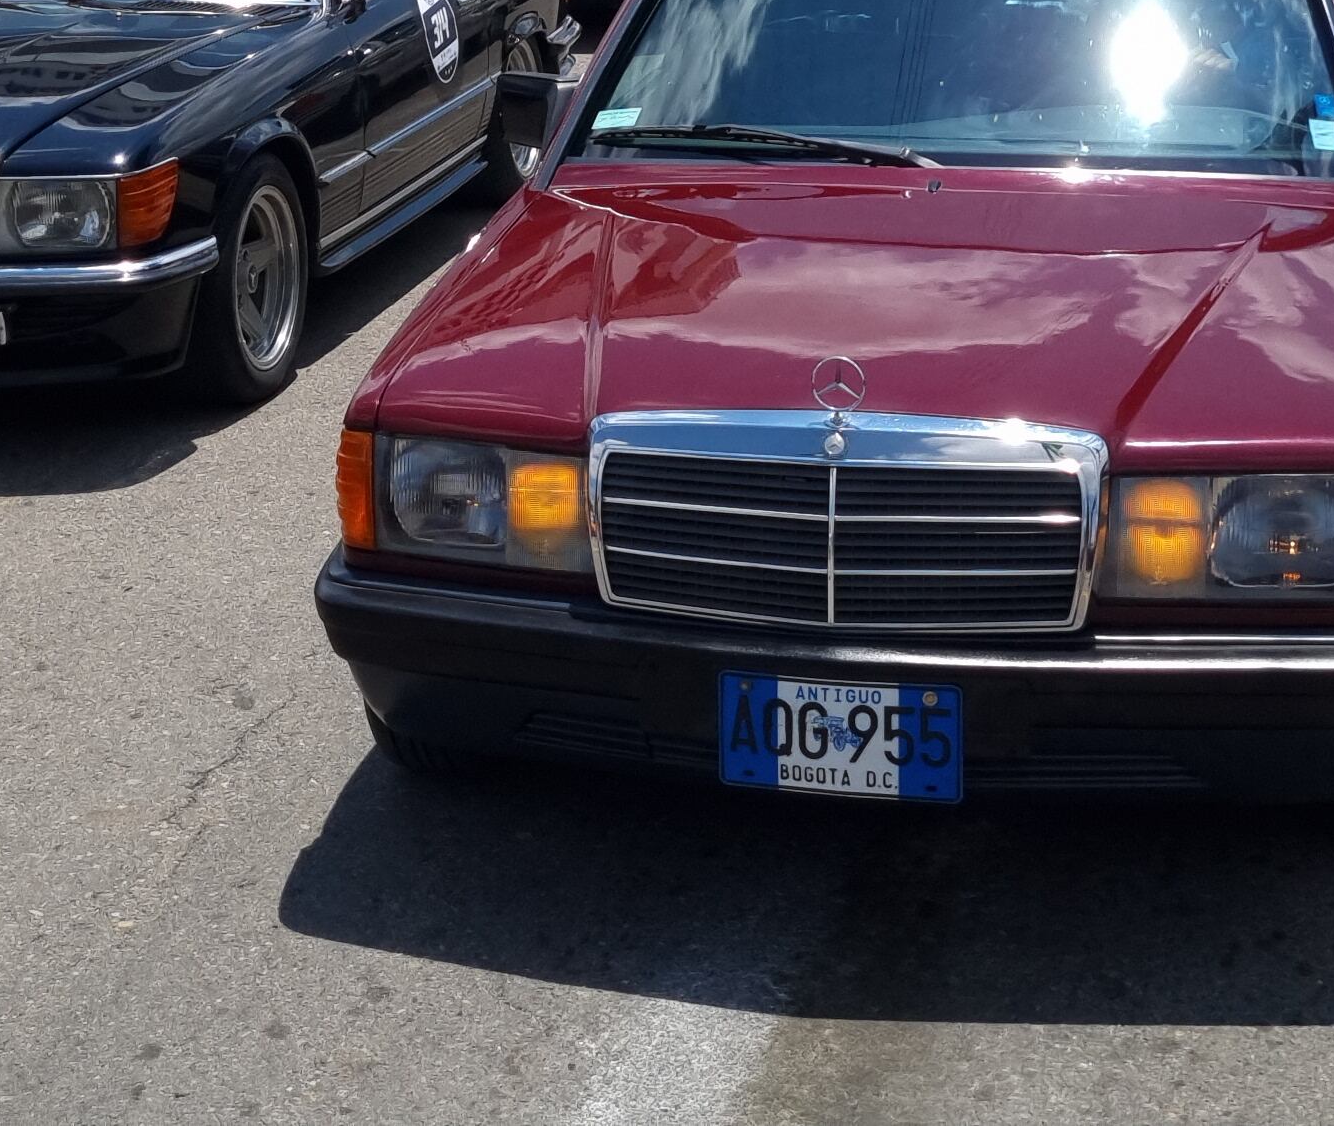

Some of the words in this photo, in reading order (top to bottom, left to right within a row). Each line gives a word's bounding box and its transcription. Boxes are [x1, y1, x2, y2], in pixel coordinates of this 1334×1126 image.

[795, 685, 882, 705] ANTIGUO
[847, 704, 952, 769] 955
[780, 764, 851, 787] BOGOTA
